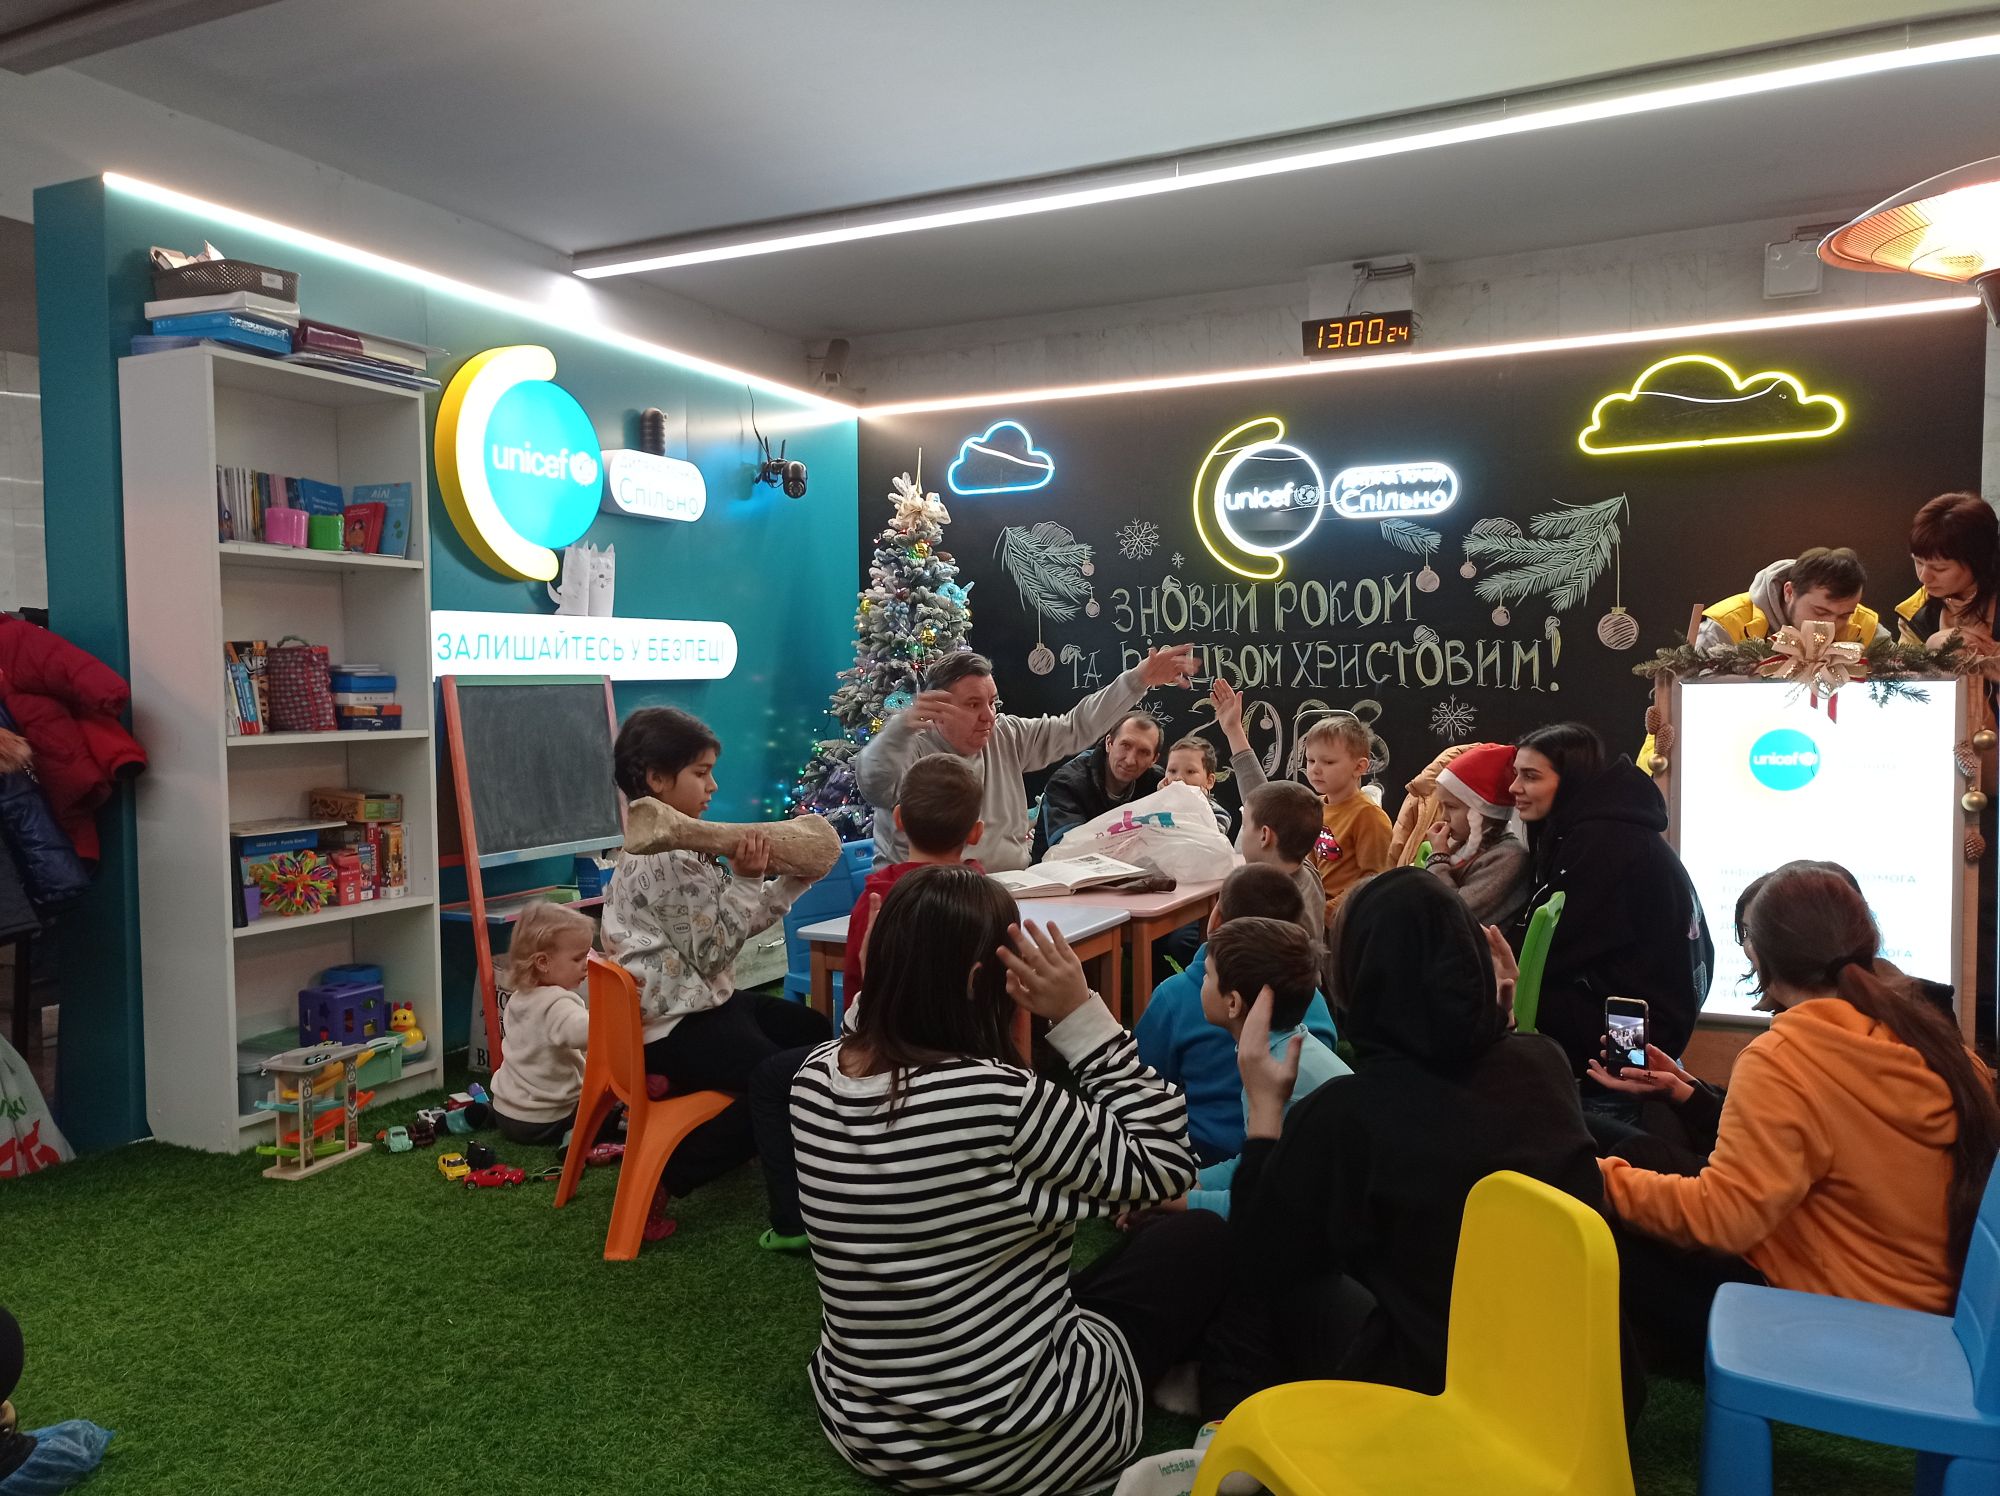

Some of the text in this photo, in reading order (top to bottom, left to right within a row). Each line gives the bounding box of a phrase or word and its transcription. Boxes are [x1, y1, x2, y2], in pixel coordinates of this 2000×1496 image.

[492, 441, 569, 481] unicef
[619, 476, 699, 516] Спільно
[1224, 481, 1296, 511] unicef
[1340, 488, 1448, 513] Спільно
[1273, 571, 1417, 633] РОКОМ
[436, 630, 724, 663] ЗАЛИШАЙТЕСЬ У БЕЗПЕЦІ
[1060, 644, 1102, 690] ТА
[1290, 616, 1562, 693] ХРИСТОВИМ!
[1753, 751, 1800, 766] unicef
